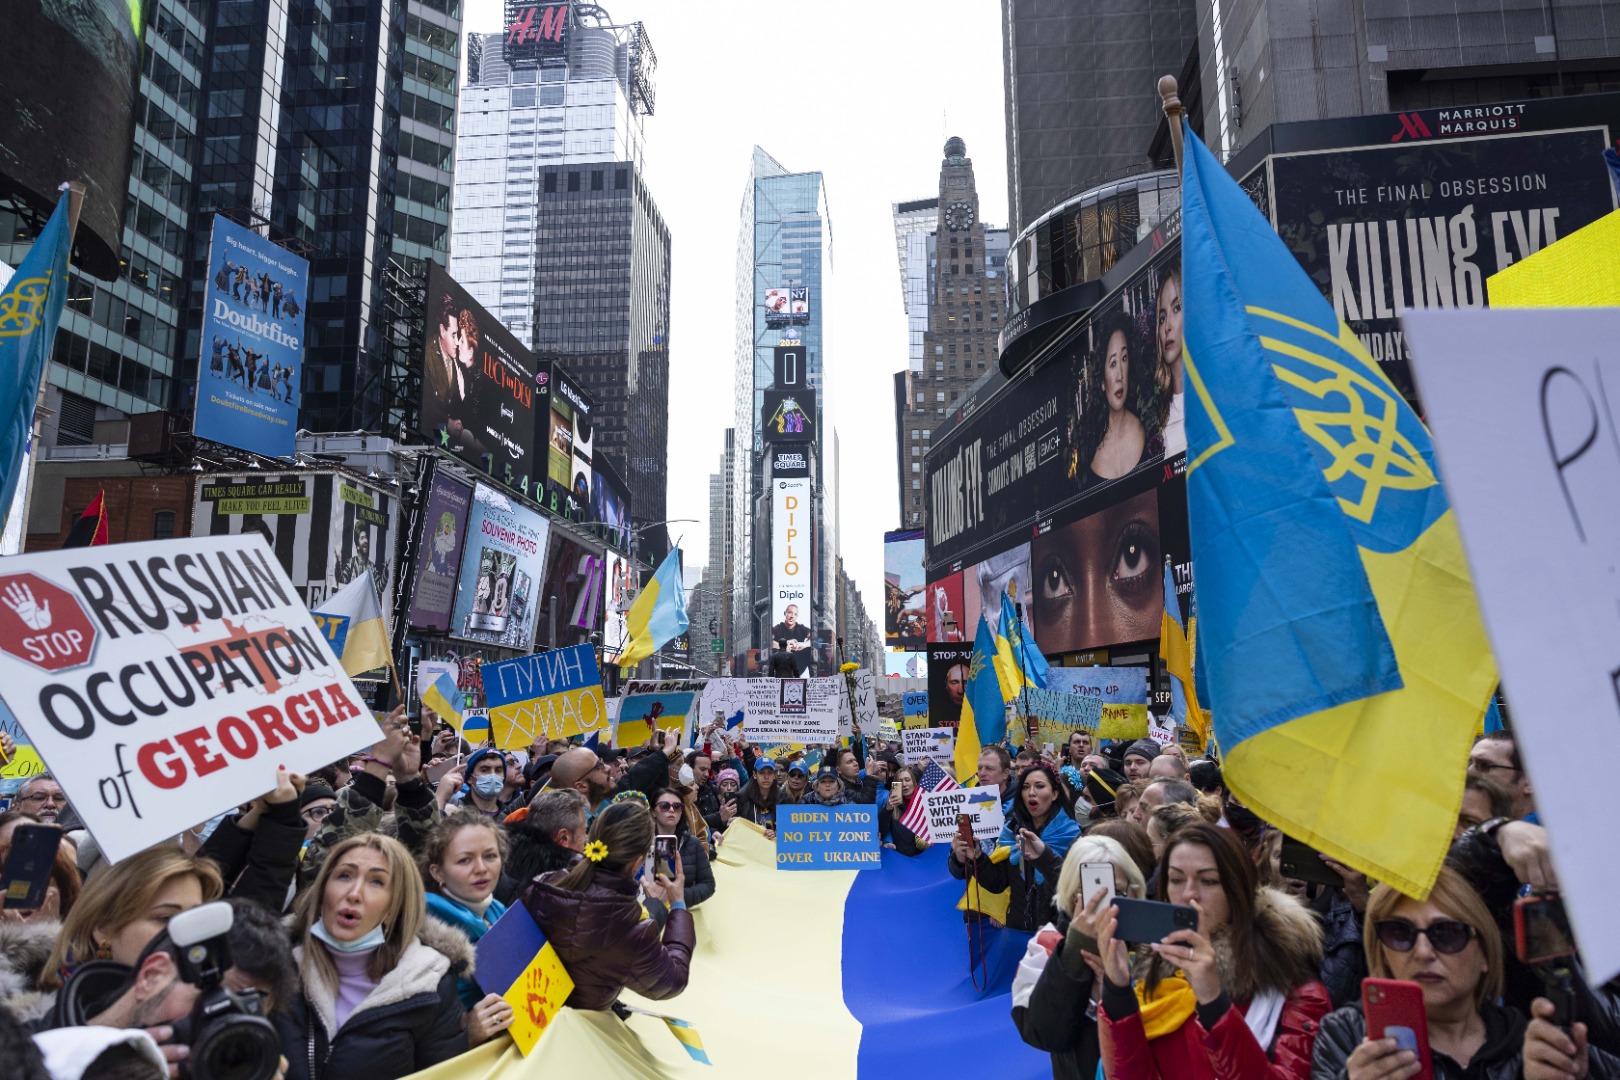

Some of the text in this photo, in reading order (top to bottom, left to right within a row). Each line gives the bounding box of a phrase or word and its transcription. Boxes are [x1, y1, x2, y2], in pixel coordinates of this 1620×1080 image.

[507, 5, 568, 45] H&M
[1439, 103, 1527, 121] MARRIOTT
[1440, 117, 1518, 135] MARQUIS
[1334, 174, 1548, 206] THE FINAL OBSESSION
[226, 235, 238, 248] Big
[278, 262, 299, 278] laughs.
[213, 298, 299, 351] Doubtfire
[780, 339, 801, 347] 2022
[483, 352, 506, 388] LUCY
[513, 377, 531, 409] DESI
[535, 386, 547, 394] LG
[560, 381, 567, 396] LG
[225, 390, 245, 403] Tickets
[210, 394, 289, 427] DoubtfireBroadway.com
[986, 397, 1058, 460] THE FINAL OBSESSION
[778, 454, 803, 462] TIMES
[774, 461, 806, 470] SQUARE
[203, 483, 303, 499] TIMES SQUARE CAN REALLY
[931, 437, 985, 548] KILLING EVE
[220, 499, 309, 512] MAKE YOU FEEL ALIVE!
[481, 519, 516, 546] SOUVENIR
[516, 535, 538, 555] PHOTO
[784, 496, 799, 576] DIPLO
[66, 548, 293, 641] RUSSIAN
[779, 590, 804, 601] Diplo
[22, 629, 84, 664] STOP
[933, 651, 958, 660] STOP
[498, 648, 585, 699] ПУТИН
[38, 626, 330, 742] OCCUPATION
[1073, 686, 1119, 697] STAND UP
[907, 696, 928, 706] OVER
[468, 709, 483, 717] FUCK
[905, 731, 932, 740] STAND
[906, 739, 928, 747] WITH
[906, 746, 940, 754] UKRAINE
[98, 682, 362, 820] of GEORGIA
[927, 794, 967, 807] STAND
[790, 812, 871, 824] BIDEN NATO
[929, 805, 961, 818] WITH
[783, 831, 872, 842] NO FLY ZONE
[776, 851, 881, 863] OVER UKRAINE
